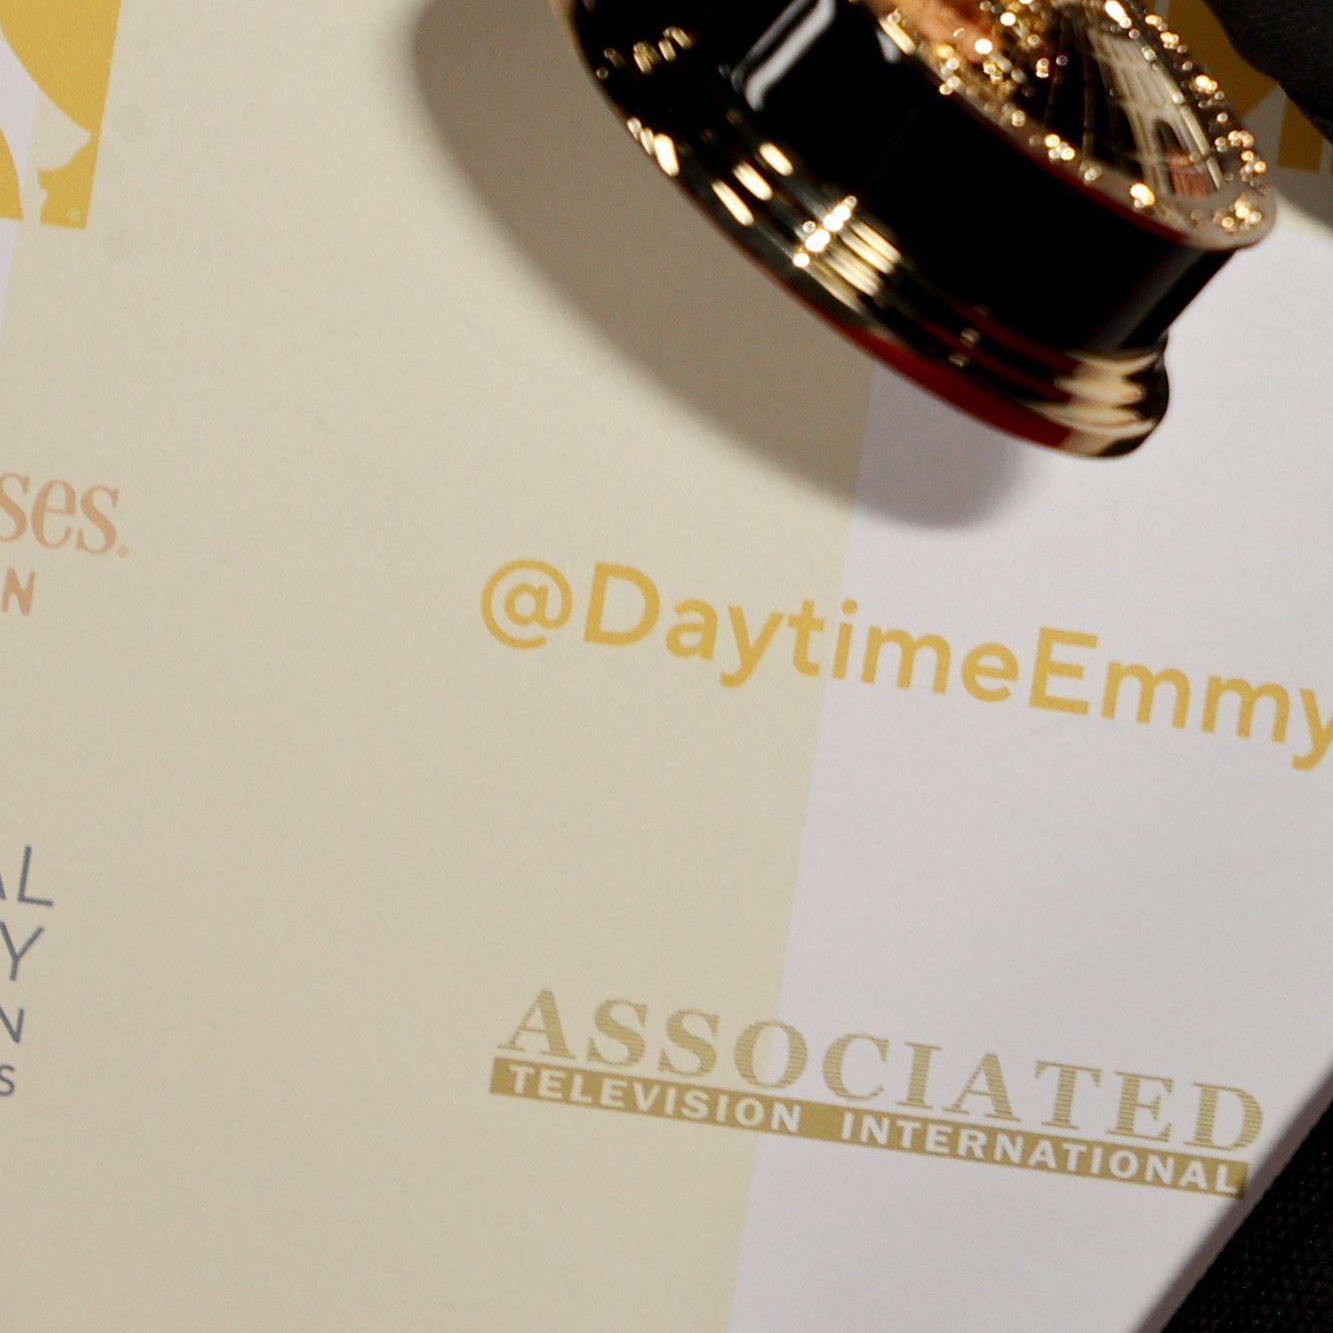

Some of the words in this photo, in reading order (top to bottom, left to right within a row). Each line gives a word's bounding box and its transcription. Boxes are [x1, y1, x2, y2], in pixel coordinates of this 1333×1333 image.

[497, 988, 1264, 1153] ASSOCIATED
[508, 1063, 801, 1134] TELEVISION
[840, 1110, 1244, 1195] INTERNATIONAL
